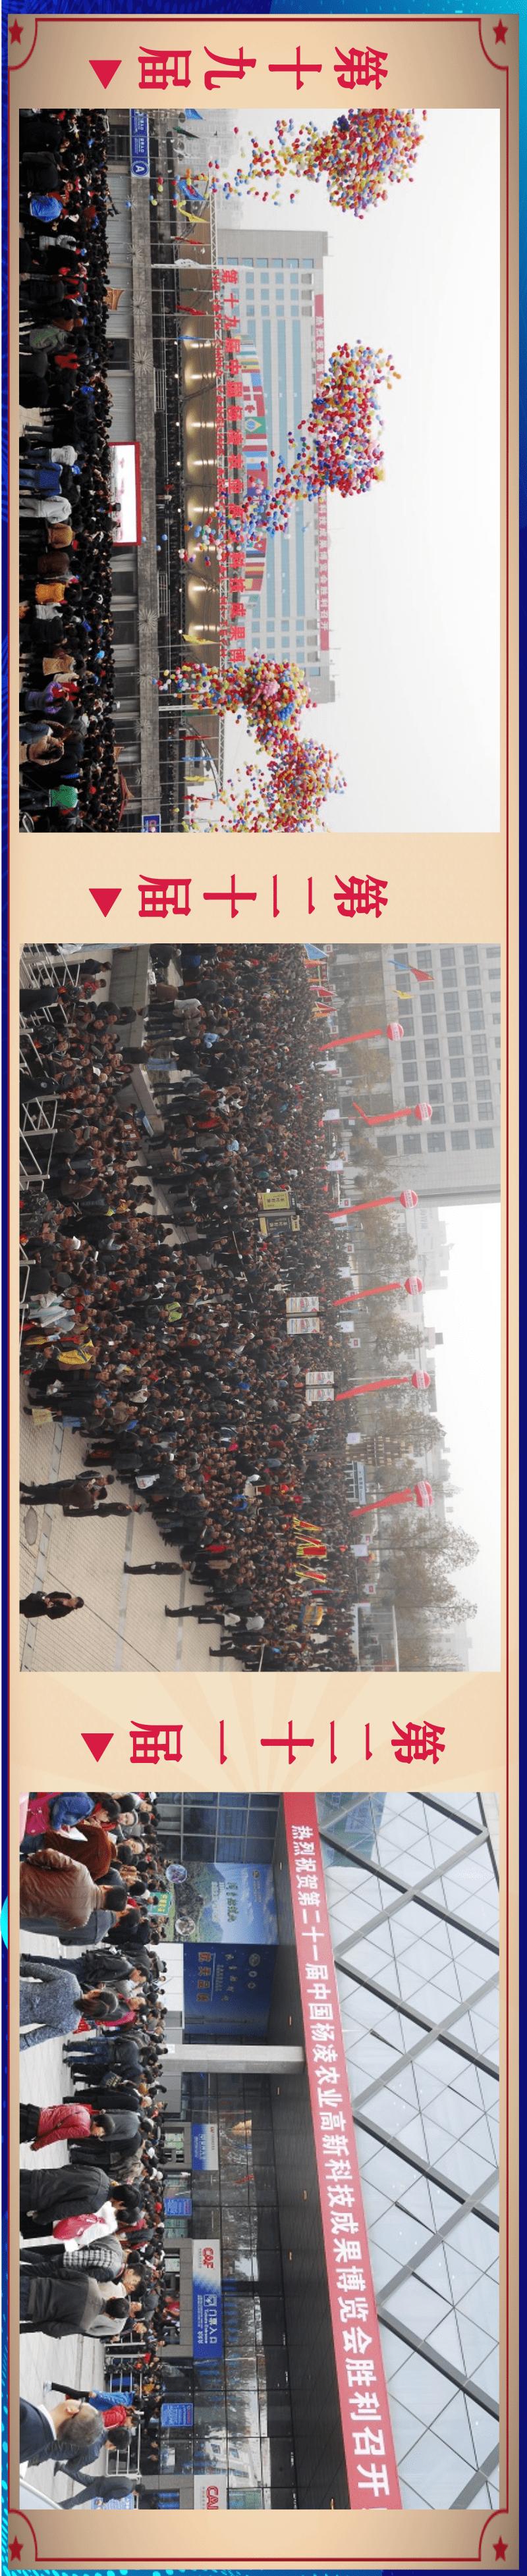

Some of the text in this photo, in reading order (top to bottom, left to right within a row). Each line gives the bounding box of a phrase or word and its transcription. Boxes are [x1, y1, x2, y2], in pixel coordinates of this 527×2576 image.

[138, 47, 387, 90] 第十九届
[215, 339, 223, 377] CHINA
[138, 874, 387, 918] 第二十届
[130, 1721, 445, 1764] 第二十一届
[291, 1825, 390, 2509] 热烈祝贺第二十一届中国杨凌农业高新科技成果博览会胜利召开
[209, 2309, 217, 2344] 门票入口
